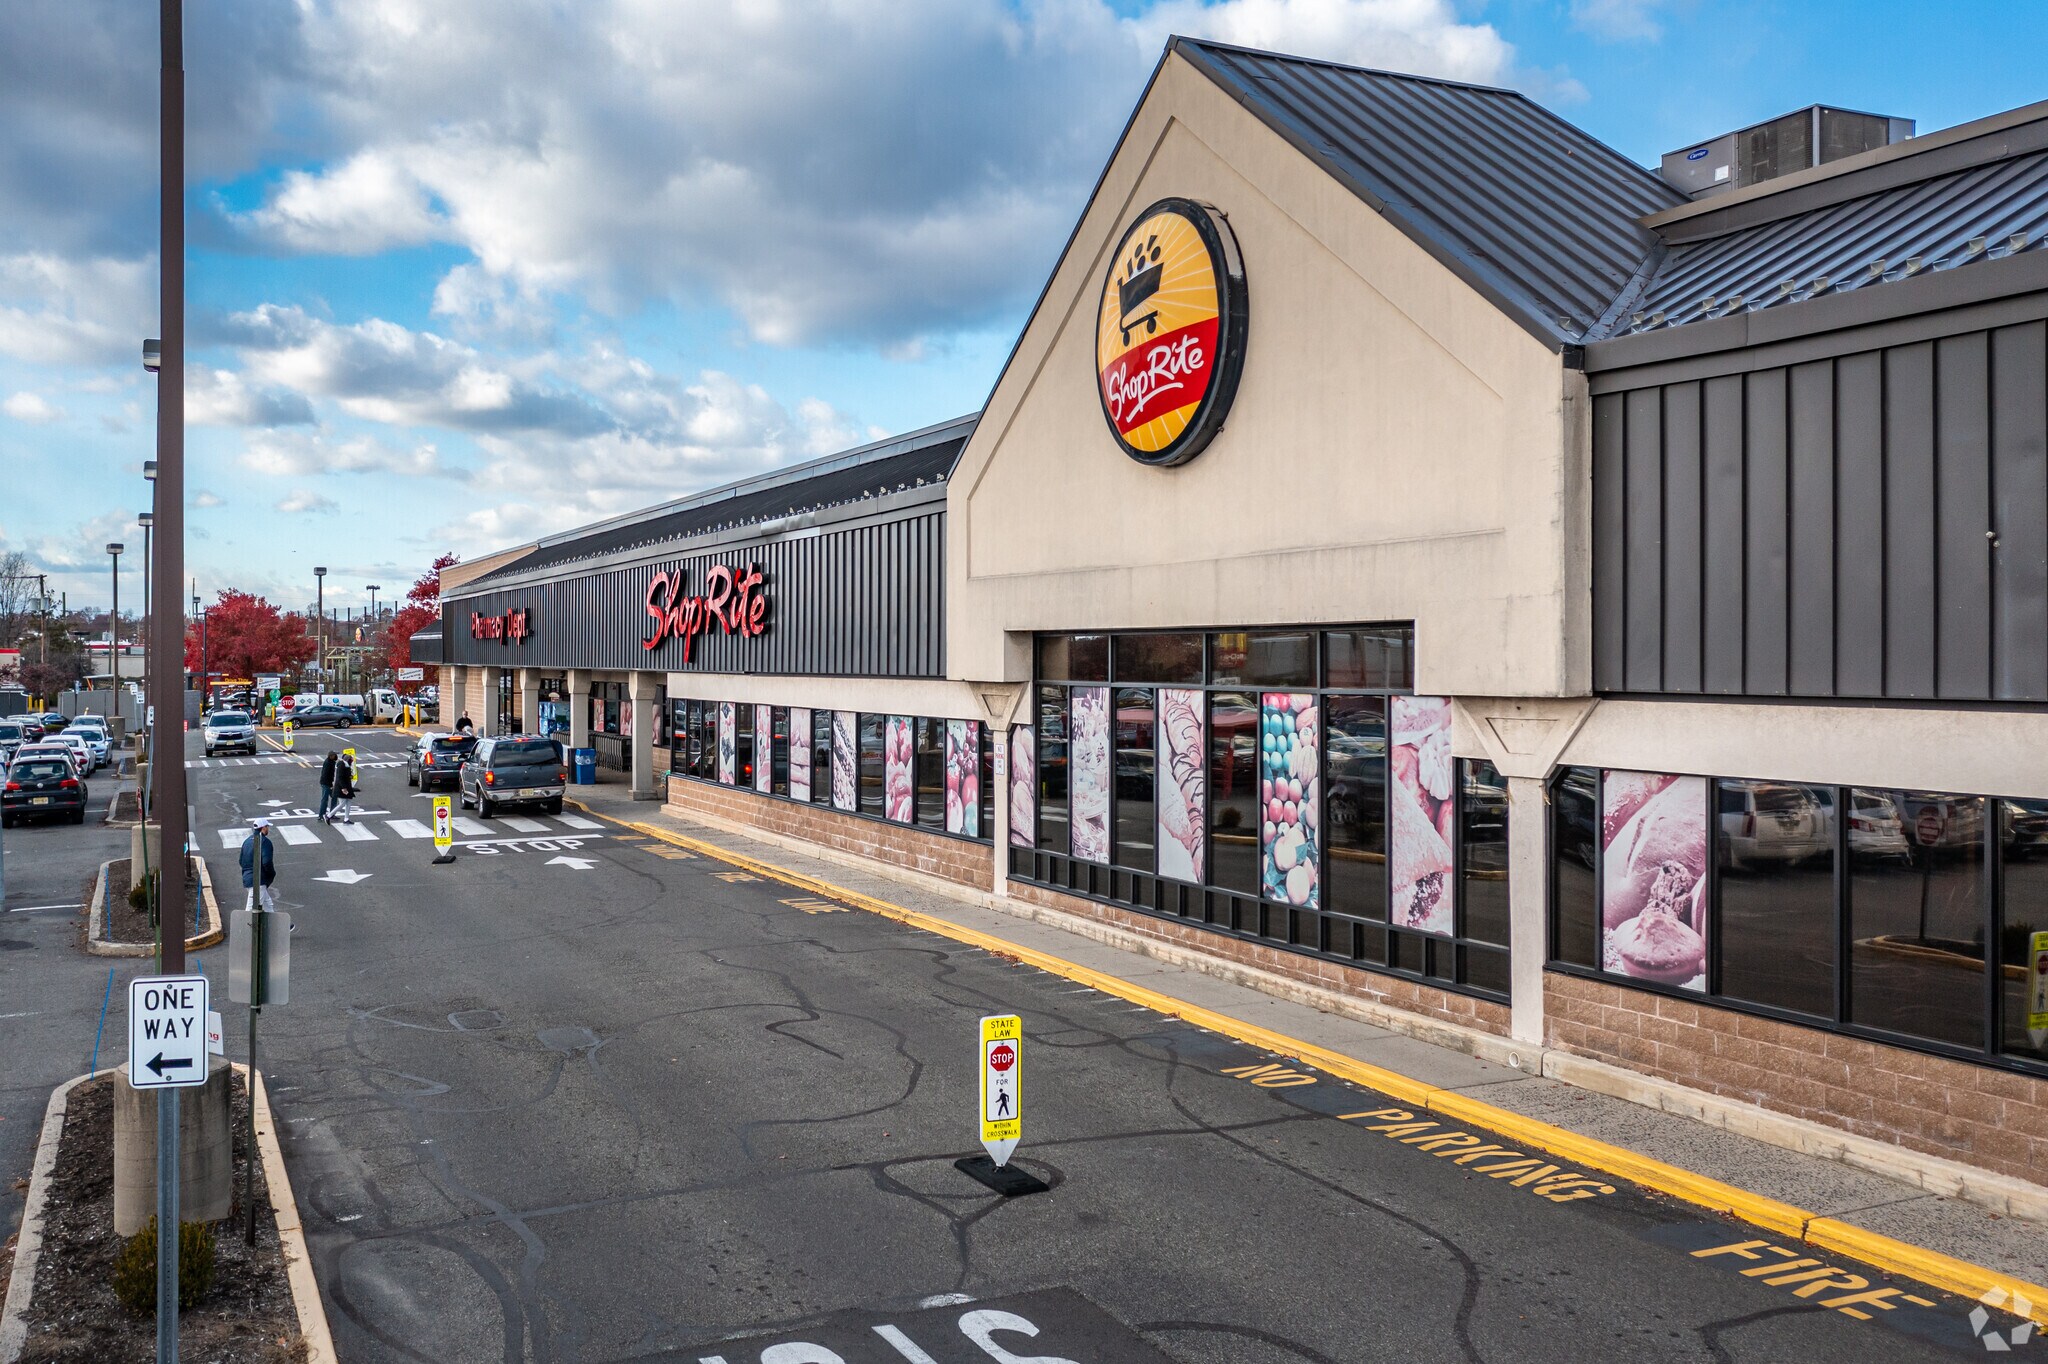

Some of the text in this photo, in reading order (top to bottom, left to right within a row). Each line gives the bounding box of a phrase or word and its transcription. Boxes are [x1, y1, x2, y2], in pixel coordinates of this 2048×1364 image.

[1107, 334, 1204, 421] ShopRite
[643, 562, 770, 663] ShopRite
[471, 607, 529, 646] Pharmacy Dept.
[466, 839, 585, 855] STOP
[144, 988, 194, 1011] ONE
[144, 1017, 194, 1040] WAY
[990, 1020, 1015, 1029] STATE
[994, 1029, 1011, 1038] LAW
[991, 1053, 1014, 1065] STOP
[995, 1078, 1009, 1086] FOR
[1220, 1063, 1318, 1088] NO
[986, 1128, 1018, 1138] CROSSWALK
[993, 1121, 1012, 1129] WITHIN
[1336, 1108, 1617, 1203] PARKING
[1689, 1239, 1937, 1320] FIRE
